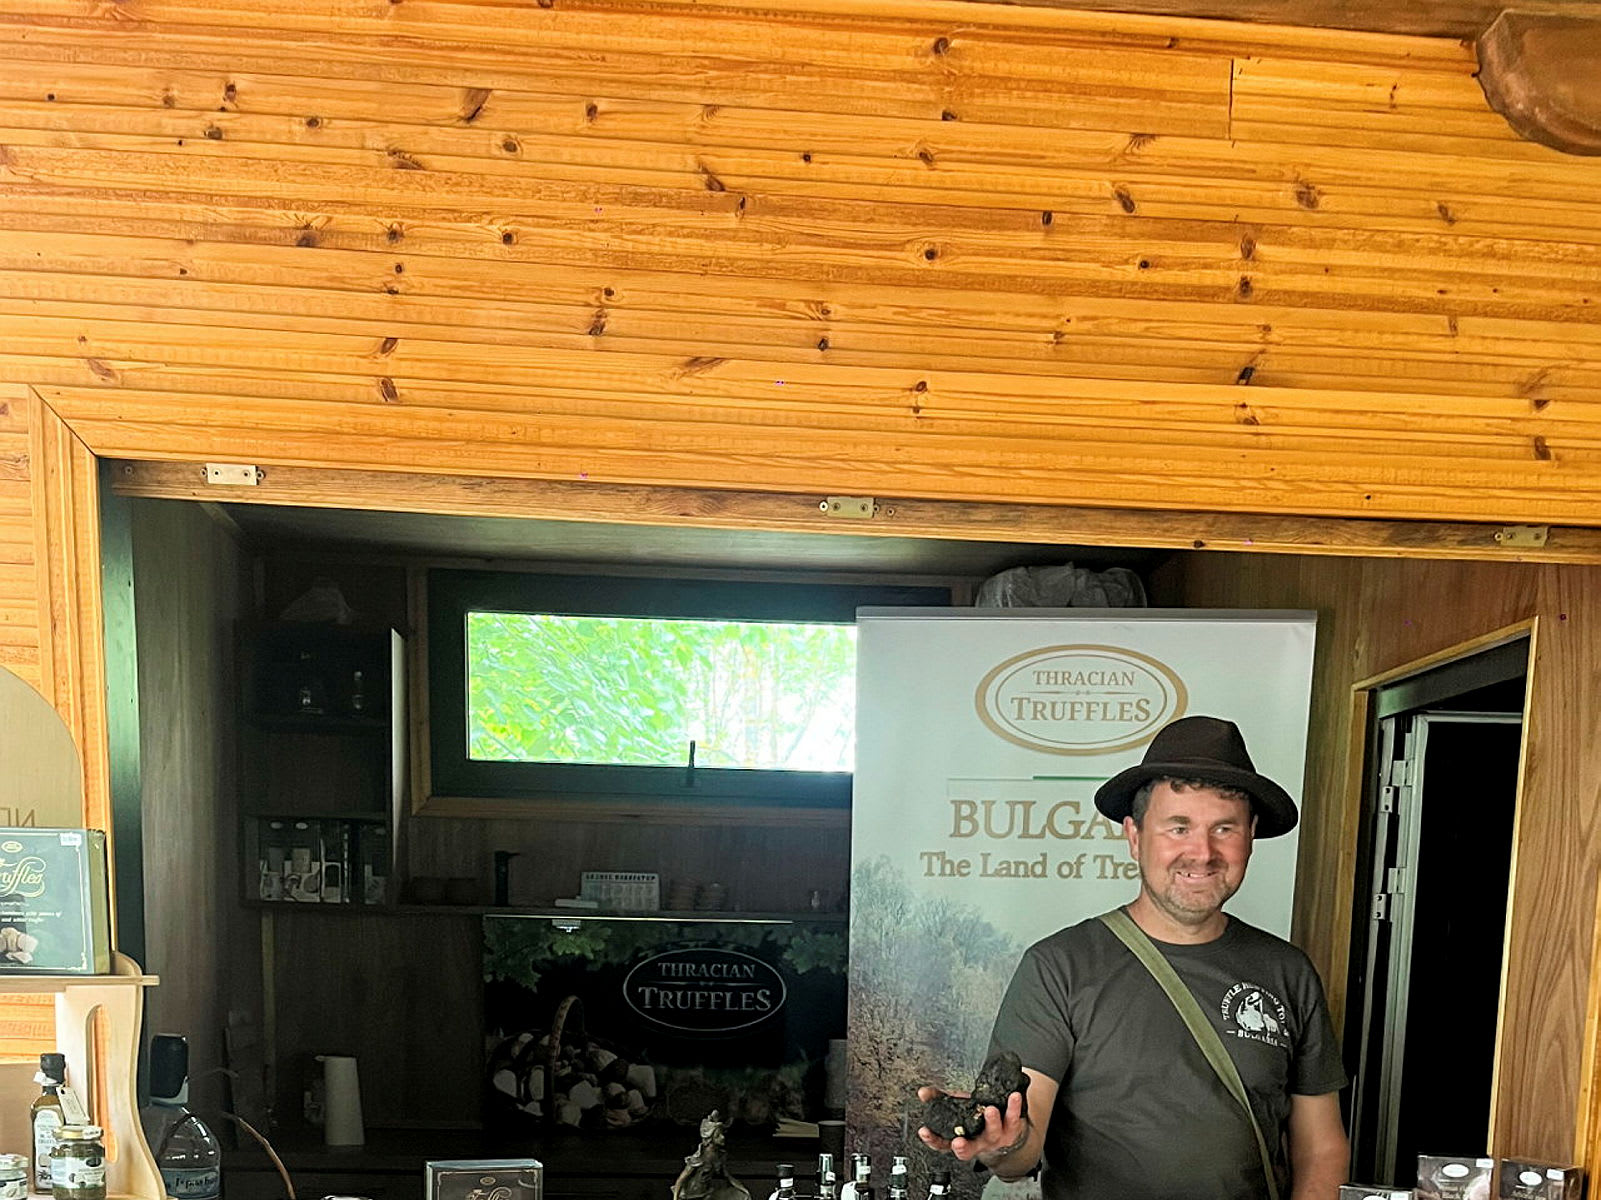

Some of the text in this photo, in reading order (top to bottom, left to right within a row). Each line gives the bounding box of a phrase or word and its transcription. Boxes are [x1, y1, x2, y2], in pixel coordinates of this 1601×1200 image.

[1033, 670, 1135, 686] THRACIAN
[1011, 697, 1151, 723] TRUFFLES
[950, 799, 1127, 840] BULGA
[920, 851, 1140, 880] The Land of Tre
[658, 962, 756, 979] THRACIAN
[638, 986, 771, 1011] TRUFFLES
